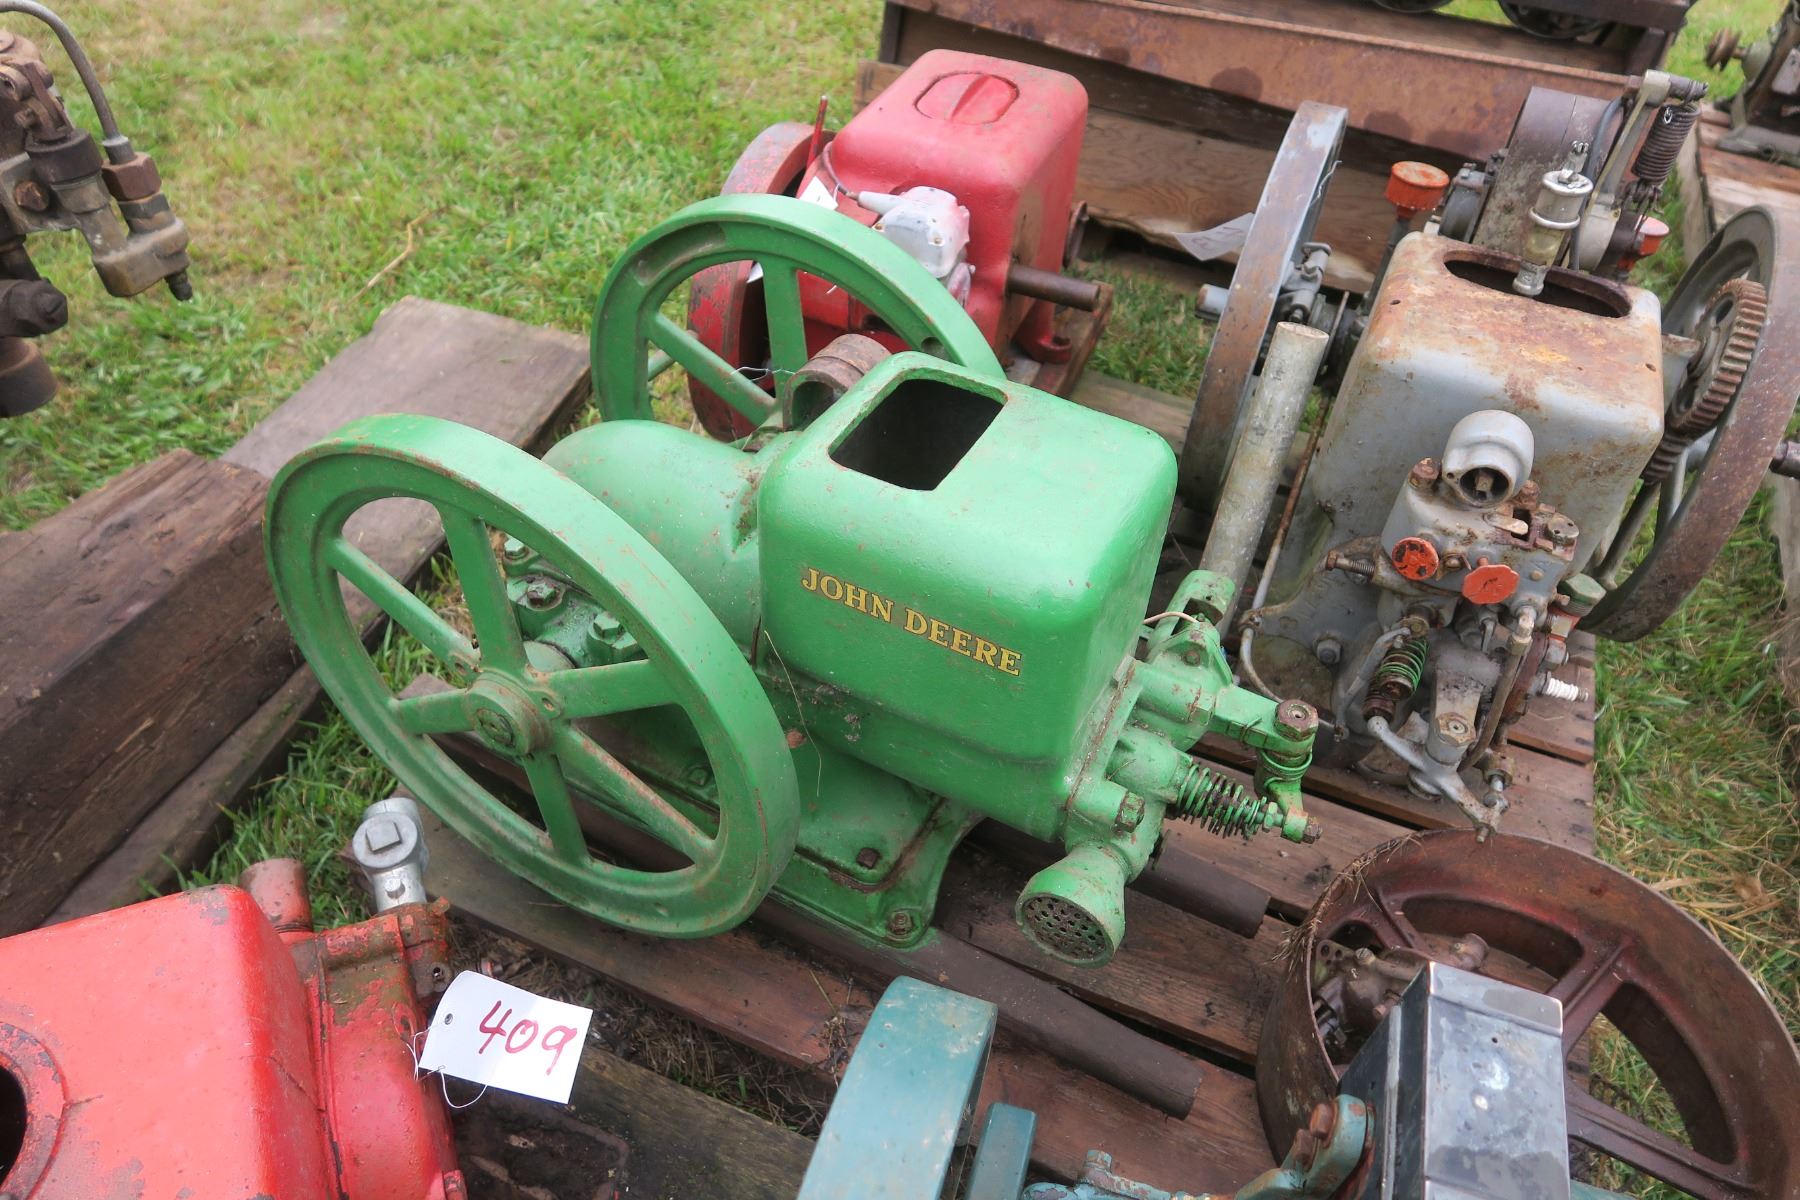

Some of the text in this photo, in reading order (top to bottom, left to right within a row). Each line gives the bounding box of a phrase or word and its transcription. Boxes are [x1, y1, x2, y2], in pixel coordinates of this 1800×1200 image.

[802, 567, 1022, 676] JOHN DEERE
[479, 1000, 577, 1075] 409
